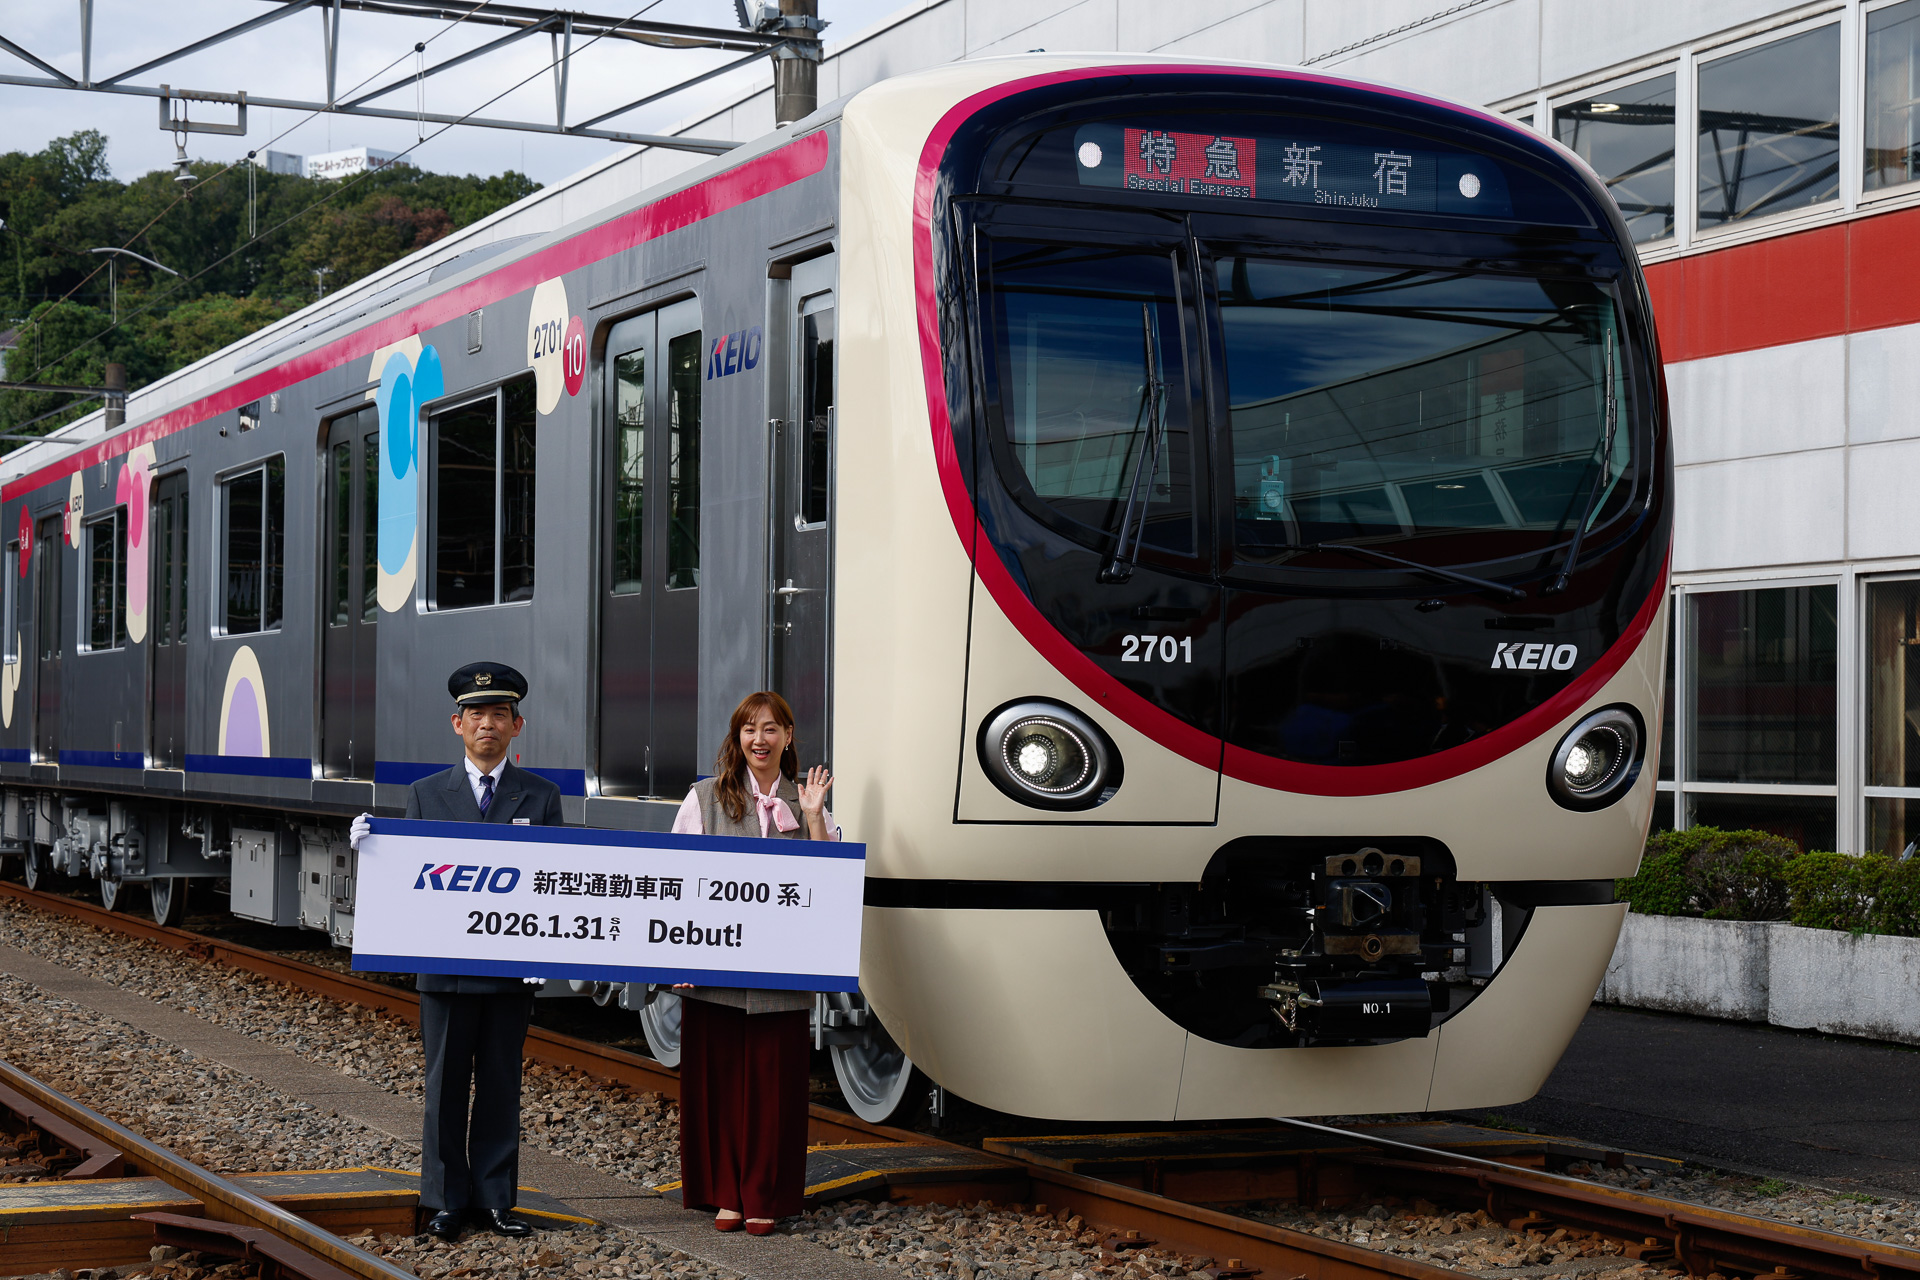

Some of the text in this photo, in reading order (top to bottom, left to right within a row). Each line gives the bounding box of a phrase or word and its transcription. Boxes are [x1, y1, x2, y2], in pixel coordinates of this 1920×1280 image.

[1140, 132, 1412, 196] 特急 新宿
[1128, 174, 1250, 198] Special Express
[1314, 189, 1378, 208] Shinjuku
[534, 318, 562, 360] 2701
[707, 325, 761, 380] KEIO
[566, 334, 583, 378] 10
[1121, 634, 1192, 663] 2701
[1491, 642, 1578, 670] KEIO
[413, 863, 521, 894] KEIO
[466, 910, 605, 940] 2026.1.31
[648, 919, 743, 947] Debut!
[1362, 1002, 1391, 1014] NO.1
